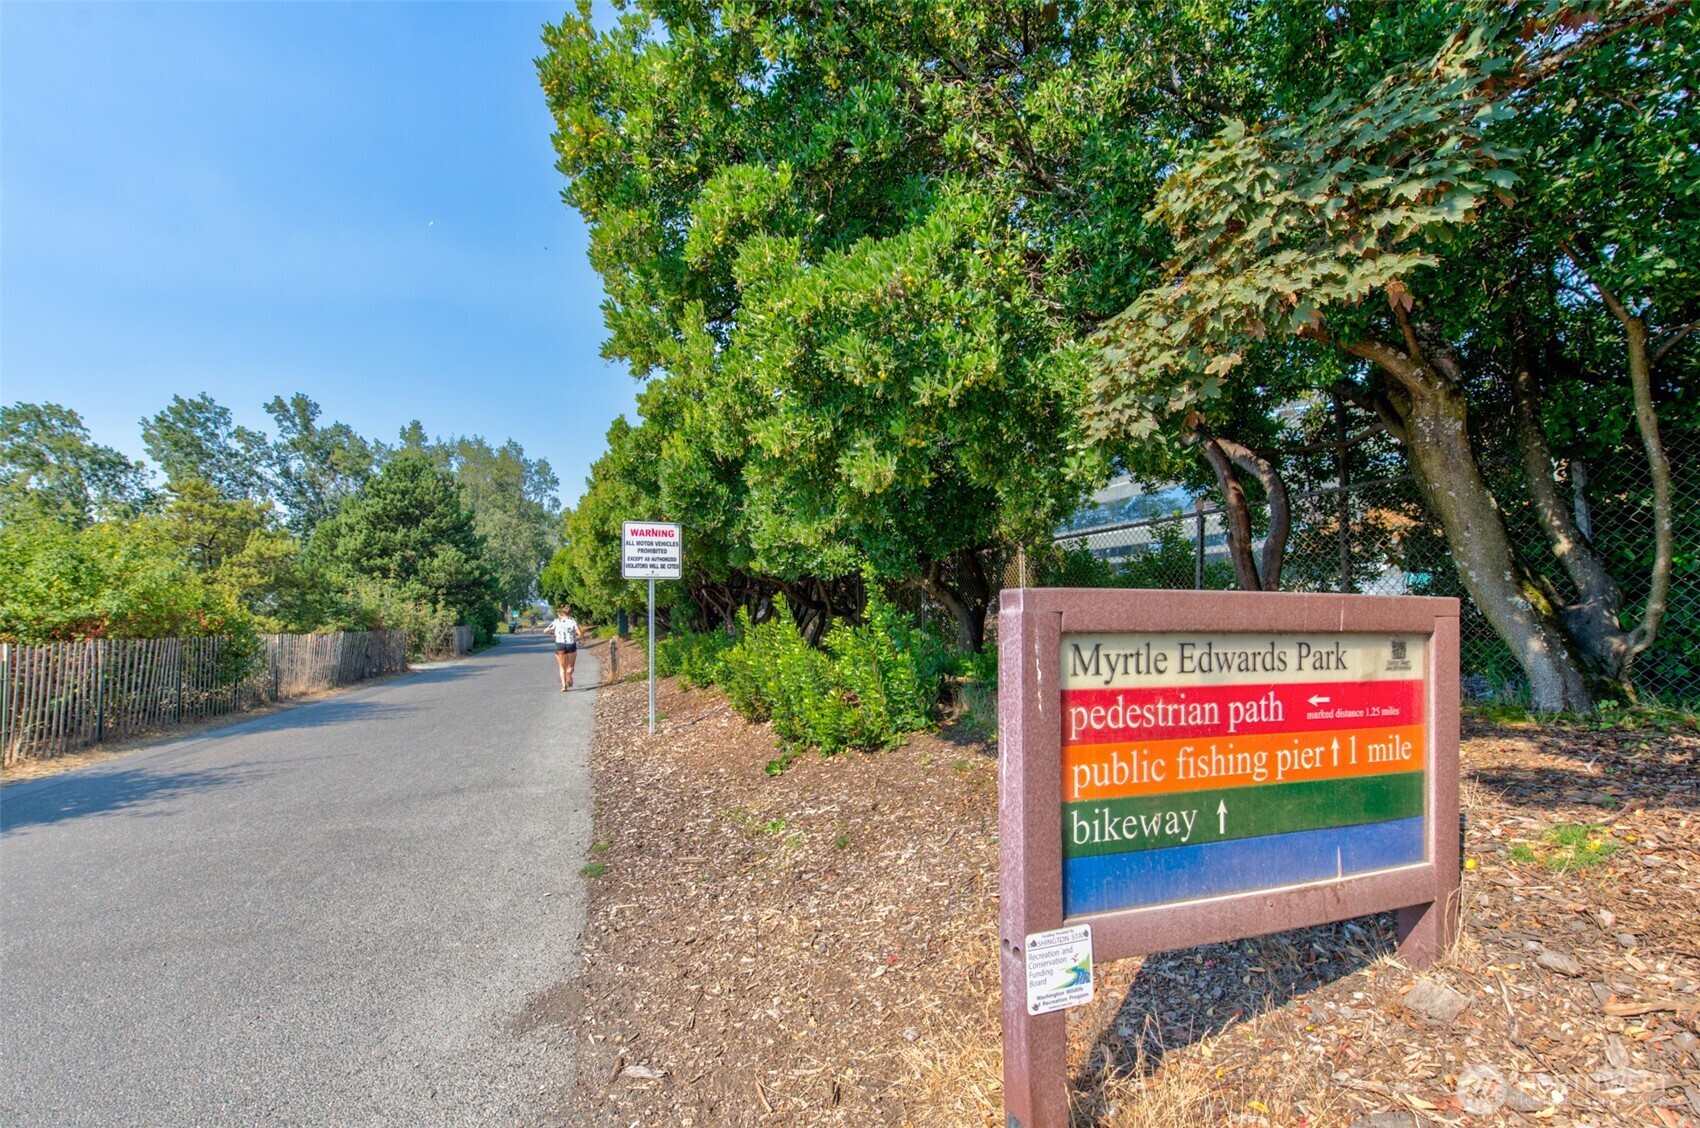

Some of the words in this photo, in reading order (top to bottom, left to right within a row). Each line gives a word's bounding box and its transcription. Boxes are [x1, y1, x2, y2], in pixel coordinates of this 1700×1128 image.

[630, 529, 675, 538] WARNING
[1069, 642, 1169, 685] Myrtle
[1177, 641, 1288, 675] Edwards
[1295, 641, 1348, 672] Park
[1069, 693, 1221, 740] pedestrian
[1227, 691, 1284, 732] path
[1306, 708, 1334, 720] marked
[1335, 708, 1364, 718] distance
[1366, 707, 1380, 716] 1.25
[1381, 706, 1400, 716] miles
[1072, 749, 1166, 798] public
[1176, 745, 1269, 783] fishing
[1276, 738, 1325, 780] pier
[1348, 736, 1358, 764] 1
[1367, 734, 1412, 763] mile
[1071, 808, 1198, 845] bikeway
[1027, 936, 1070, 948] WSHINGTON
[1028, 950, 1060, 961] Recreation
[1062, 946, 1073, 954] and
[1028, 956, 1067, 970] Conservation
[1029, 968, 1053, 979] Funding
[1030, 978, 1047, 988] Board
[1036, 992, 1064, 1000] Washington
[1042, 997, 1068, 1006] Recreation
